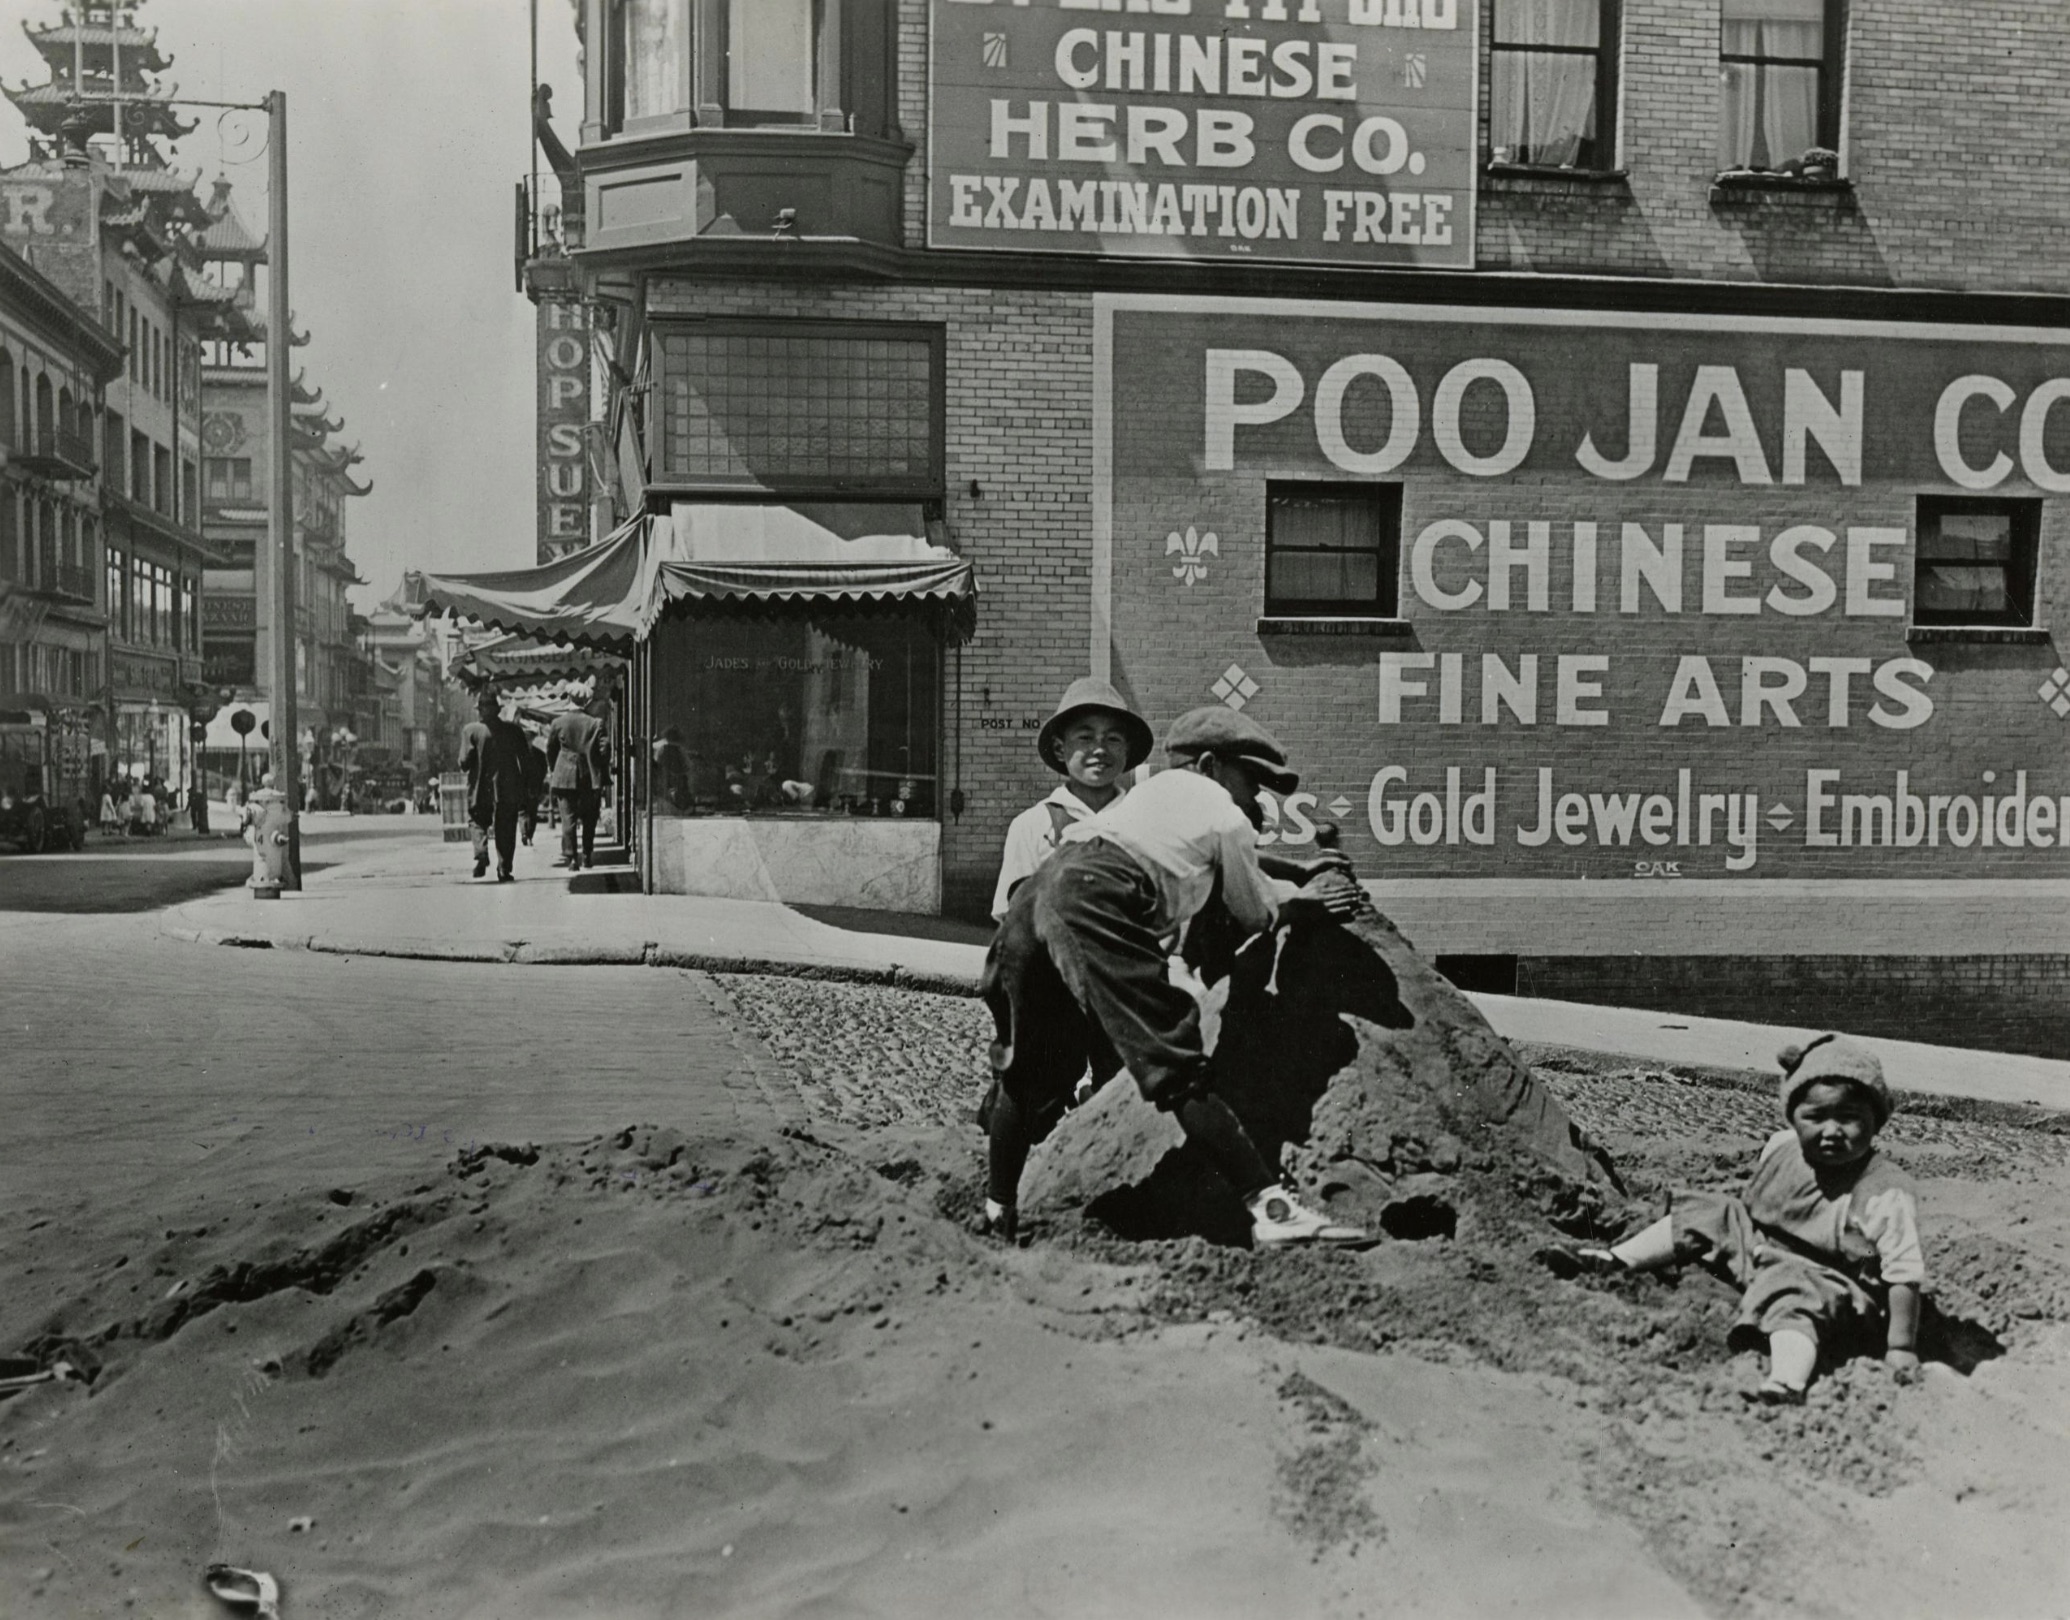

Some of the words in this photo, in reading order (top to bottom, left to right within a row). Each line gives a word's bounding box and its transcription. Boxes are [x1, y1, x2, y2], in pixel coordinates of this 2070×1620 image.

[1055, 27, 1358, 100] CHINESE
[990, 98, 1256, 166] HERB
[1288, 113, 1426, 175] CO.
[949, 174, 1301, 239] EXAMINATION
[1323, 190, 1453, 245] FREE
[1204, 348, 1535, 480] POO
[1575, 362, 1865, 486] JAN
[1411, 518, 1907, 616] CHINESE
[703, 655, 749, 670] JADES
[778, 655, 813, 671] GOLD
[1378, 652, 1609, 726] FINE
[1659, 655, 1935, 729] ARTS
[981, 719, 1013, 729] POST
[1023, 719, 1041, 729] NO
[1367, 765, 1496, 846] Gold
[1517, 767, 1758, 871] Jewelry
[1634, 861, 1682, 877] OAK
